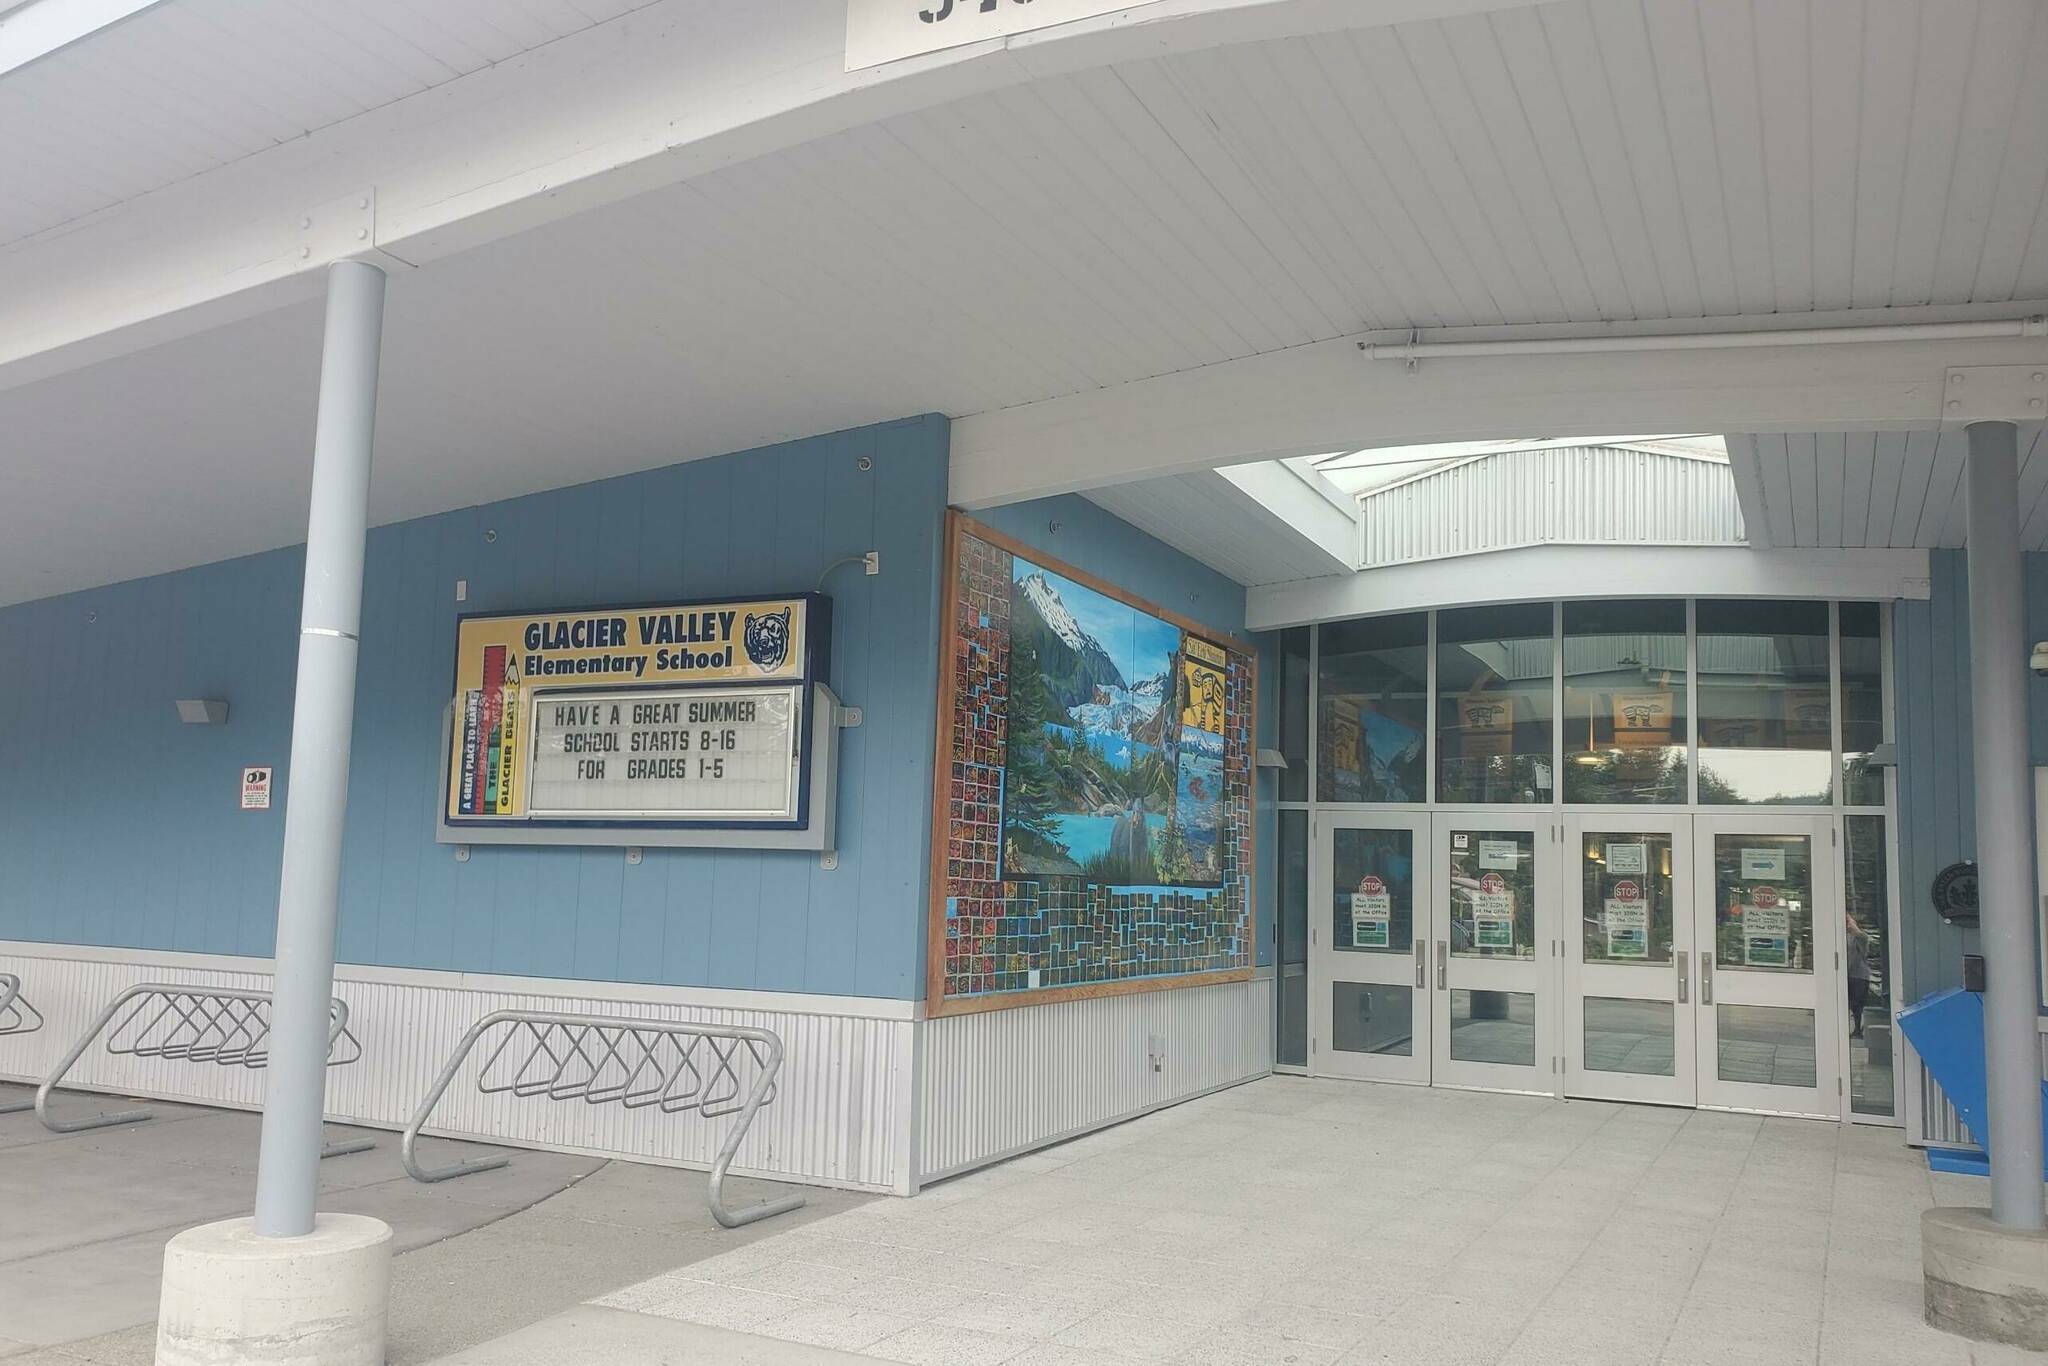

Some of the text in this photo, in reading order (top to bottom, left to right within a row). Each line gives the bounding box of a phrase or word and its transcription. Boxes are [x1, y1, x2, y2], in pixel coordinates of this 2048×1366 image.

[525, 611, 736, 650] GLACIER VALLEY
[525, 646, 733, 677] Elementary School
[555, 701, 756, 726] HAVE A GREAT SUMMER
[467, 729, 476, 743] TO
[564, 729, 736, 753] SCHOOL STARTS 8-16
[466, 746, 475, 769] PLACE
[501, 691, 516, 807] GLACIER BEARS
[489, 761, 498, 789] THE
[577, 758, 723, 779] FOR GRADES 1-5
[464, 772, 473, 800] GREAT
[1362, 882, 1381, 891] STOP
[1482, 879, 1503, 890] STOP
[1616, 887, 1638, 897] STOP
[1753, 893, 1777, 904] STOP
